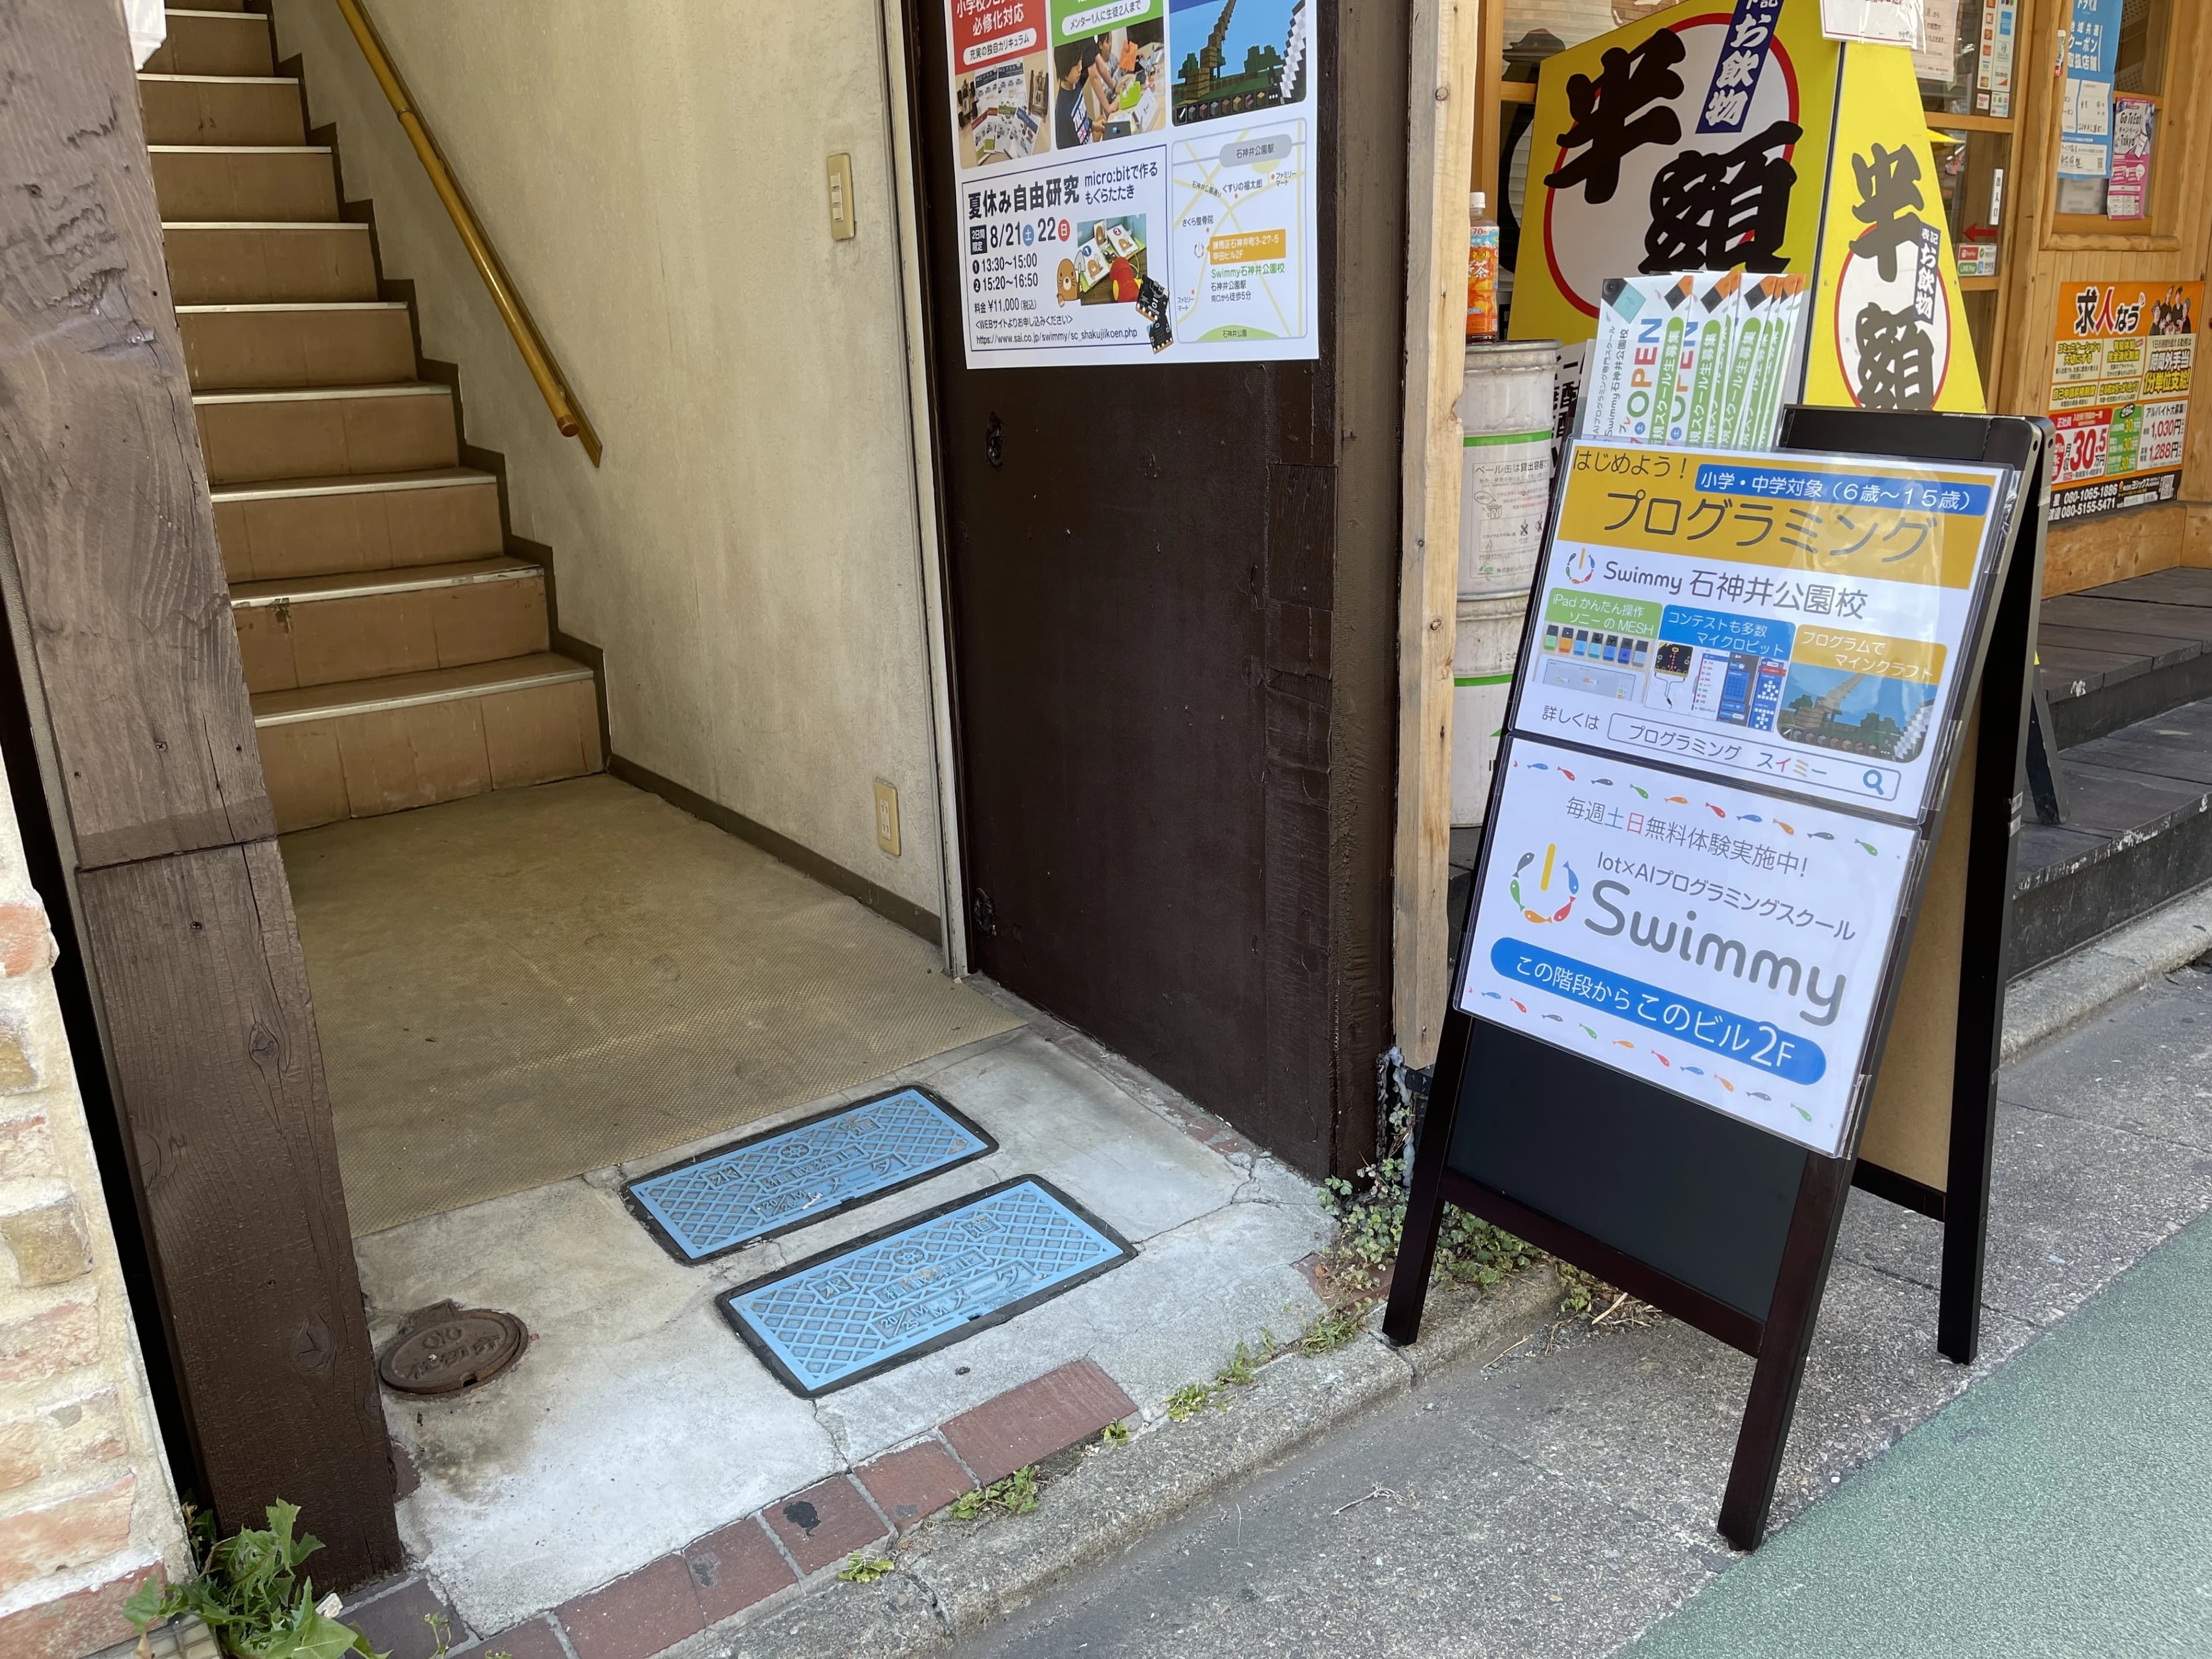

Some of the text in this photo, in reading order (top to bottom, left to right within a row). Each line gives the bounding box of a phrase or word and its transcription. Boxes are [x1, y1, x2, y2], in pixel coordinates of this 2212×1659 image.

[972, 3, 1024, 36] 必修化対応
[1070, 1, 1141, 29] メンター1人に生徒2人まで
[970, 33, 1029, 60] 充実の独自カリキュラム
[1706, 14, 1771, 126] お飲物
[1236, 143, 1274, 158] 石神井公園駅
[1544, 28, 1804, 274] 半額
[1085, 161, 1158, 187] micro:bitで作る
[1222, 179, 1263, 193] くすりの福太郎
[968, 175, 1080, 219] 夏休み自由研究
[1085, 184, 1134, 205] もぐらたたき
[990, 221, 1021, 249] 8/21
[1037, 217, 1056, 242] 22
[1182, 215, 1214, 228] さくら整骨院
[1211, 263, 1285, 278] Swimmy石神井公園校
[1849, 142, 1935, 410] 半額
[1915, 243, 1937, 320] お飲物
[1211, 279, 1247, 291] 石神井公園駅
[1211, 291, 1251, 302] 南口から徒歩5分
[975, 301, 986, 314] 料金
[988, 298, 1020, 313] ¥11,000
[2075, 287, 2141, 335] 求人なう
[1222, 329, 1247, 338] 石神井公園
[1627, 319, 1663, 418] OPEN
[1573, 450, 1687, 479] はじめよう！
[1604, 488, 1938, 562] プログラミング
[1603, 560, 1869, 620] Swimmy 石神井公園校
[1553, 593, 1645, 618] iPad かんたん操作
[1570, 612, 1654, 636] ソニー の MESH
[1668, 612, 1768, 638] コンテストも多数
[1696, 632, 1784, 657] マイクロビット
[1802, 631, 1887, 655] プログラムで
[1835, 654, 1933, 681] マインクラフト
[1541, 704, 1827, 778] 詳しくは プログラミング スイミー
[1584, 879, 1847, 1027] Swimmy
[822, 1275, 851, 1301] 水
